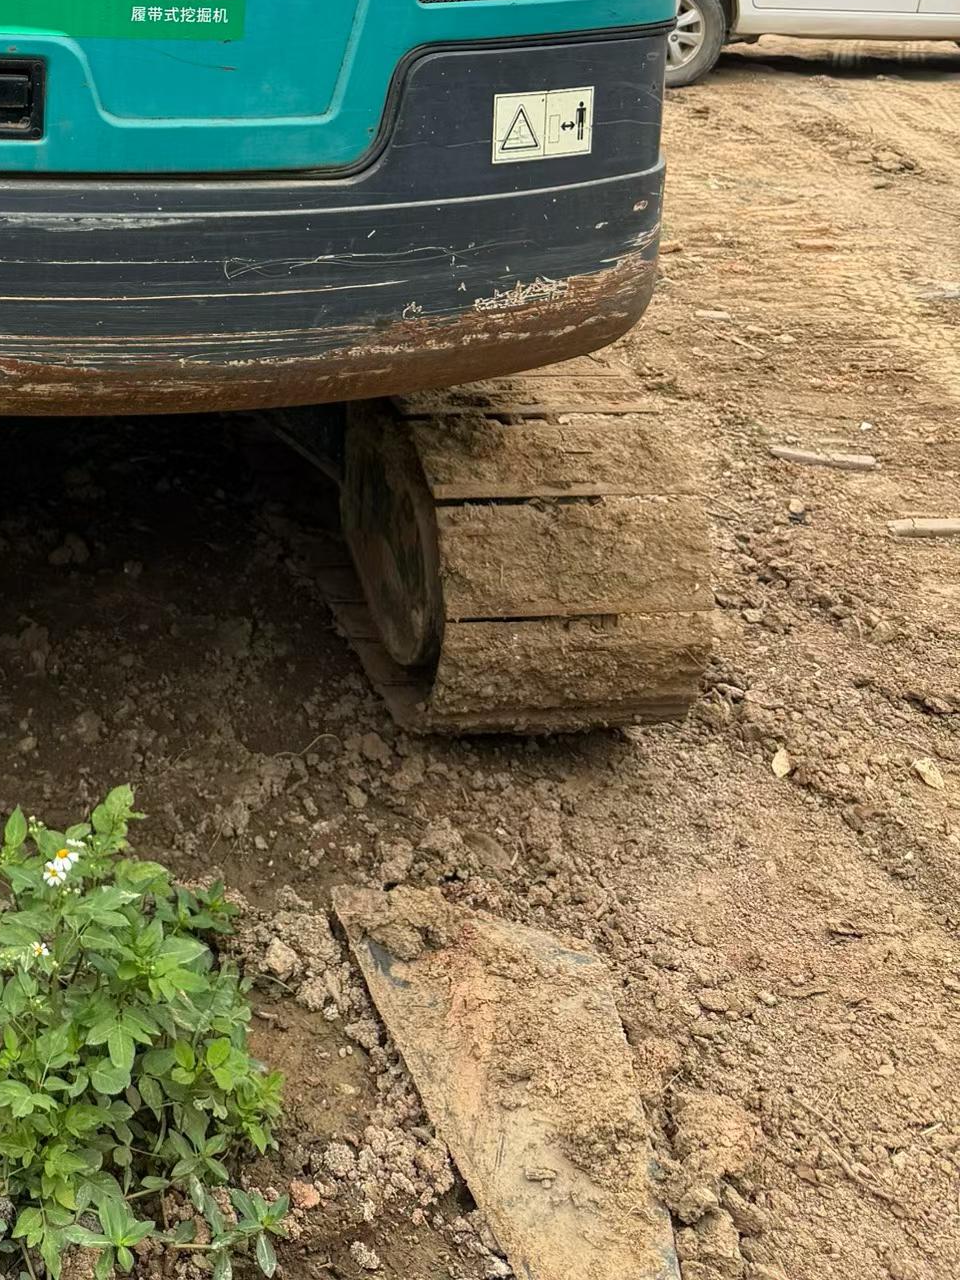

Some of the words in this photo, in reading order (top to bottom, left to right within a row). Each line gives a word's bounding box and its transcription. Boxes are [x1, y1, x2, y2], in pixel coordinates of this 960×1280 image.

[131, 6, 228, 23] 履带式挖掘机
